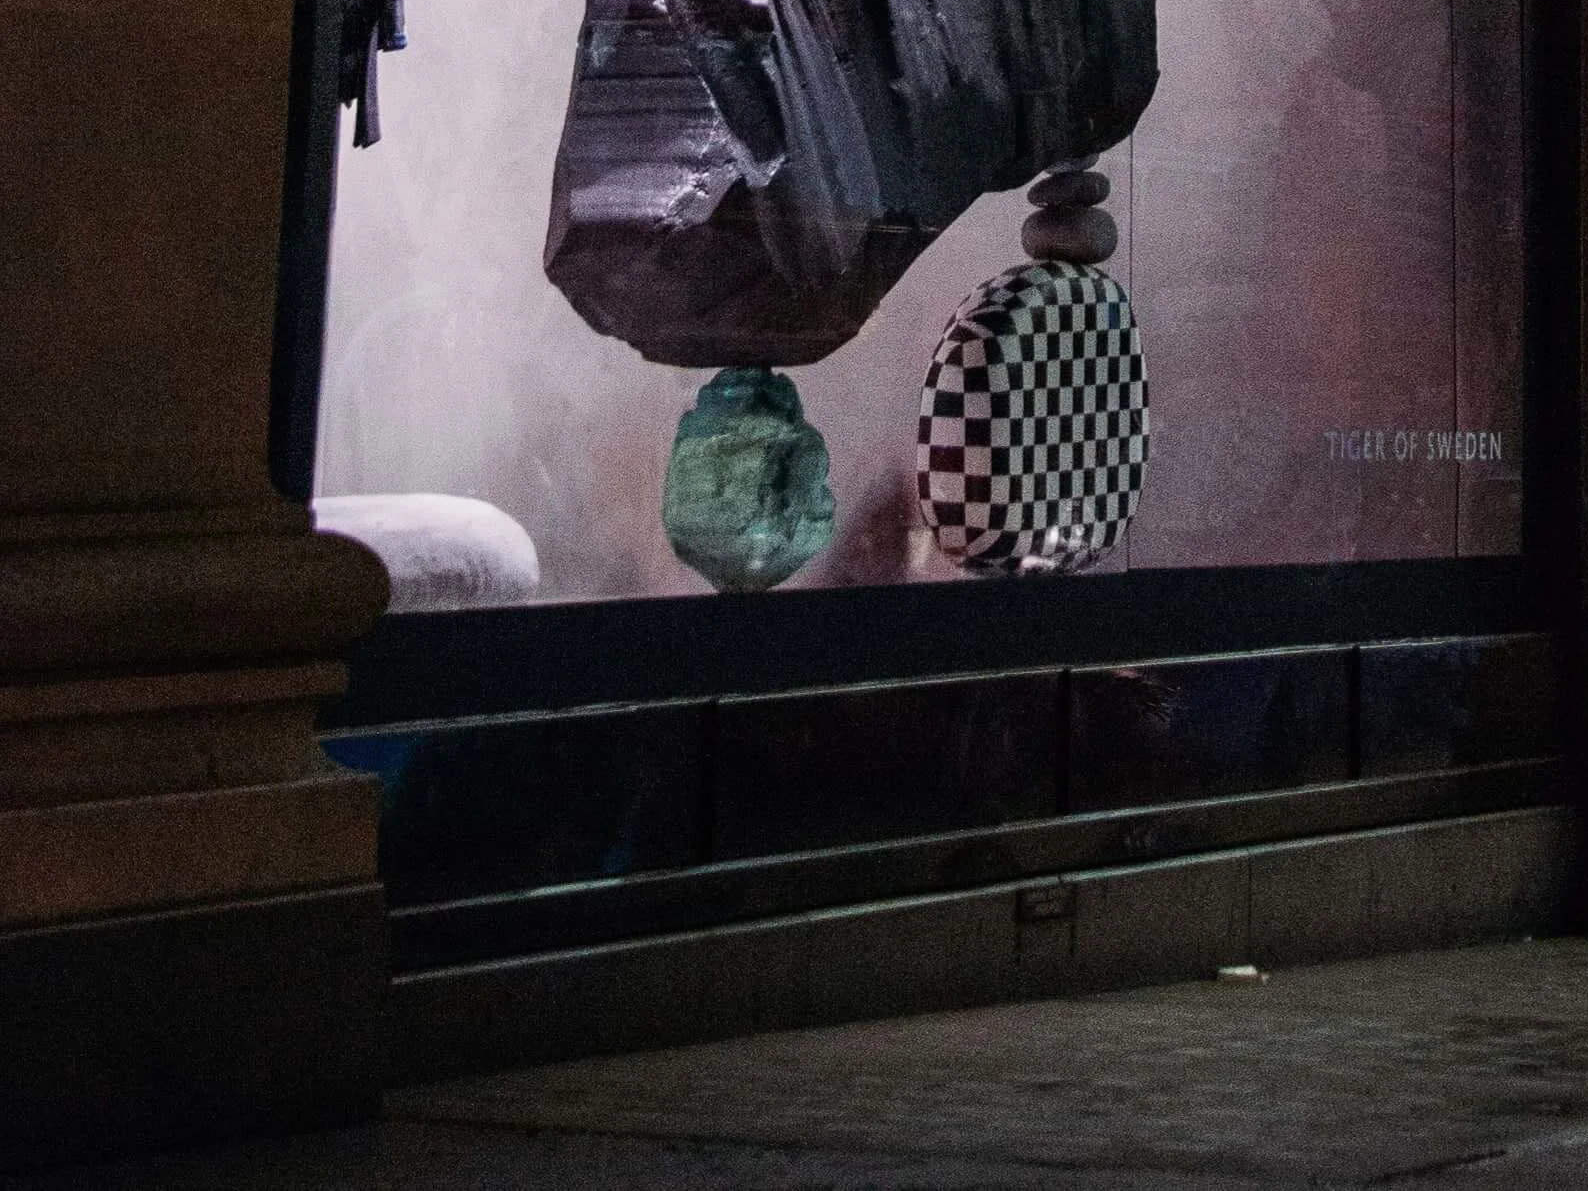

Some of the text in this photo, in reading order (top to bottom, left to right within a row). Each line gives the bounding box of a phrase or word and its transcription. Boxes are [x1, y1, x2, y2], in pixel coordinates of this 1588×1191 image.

[1324, 430, 1502, 460] TIGER OF SWEDEN
